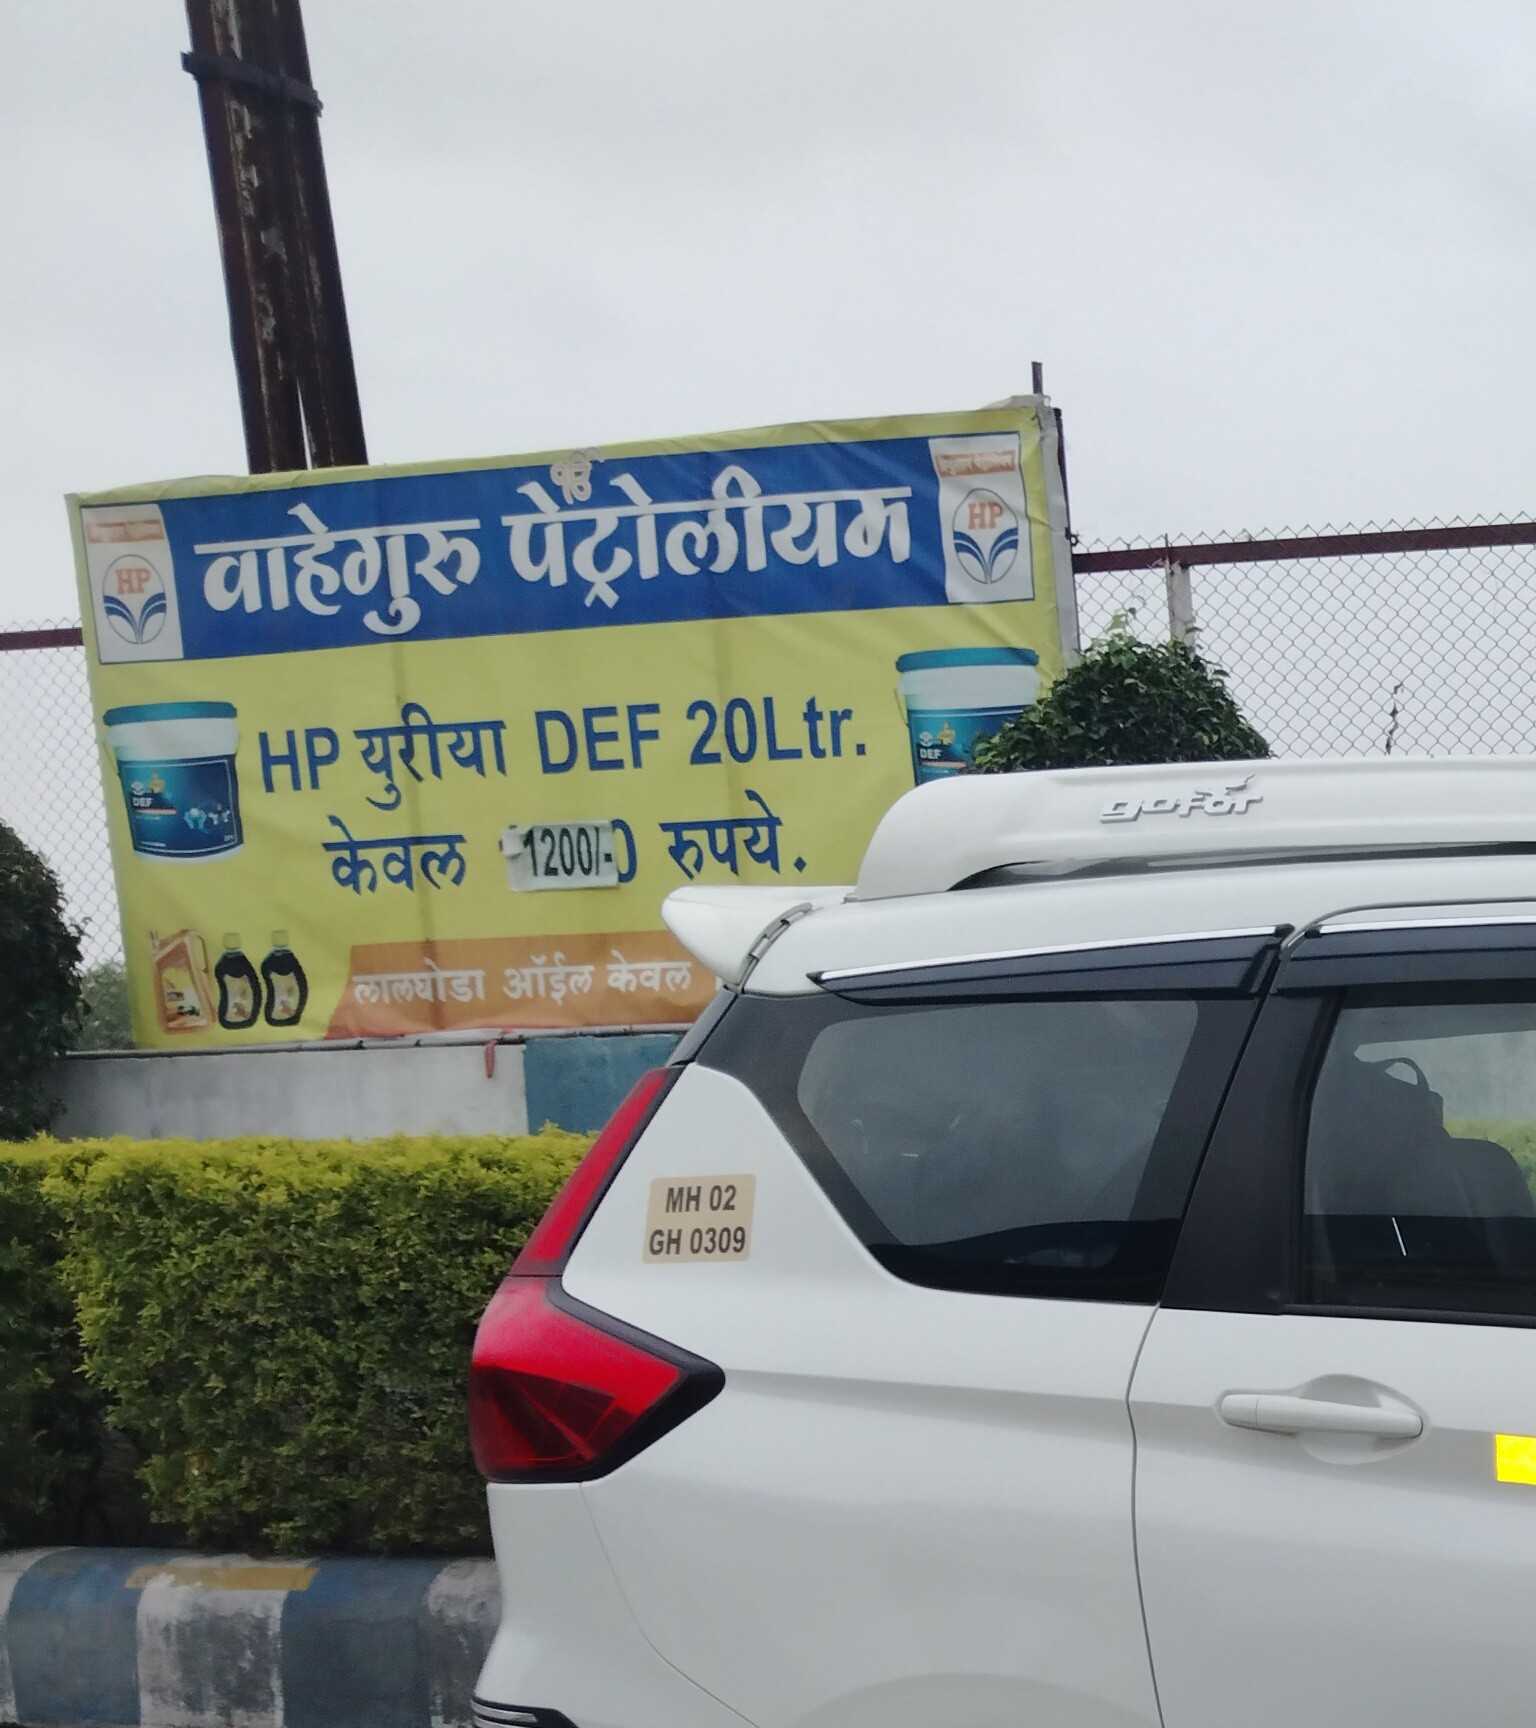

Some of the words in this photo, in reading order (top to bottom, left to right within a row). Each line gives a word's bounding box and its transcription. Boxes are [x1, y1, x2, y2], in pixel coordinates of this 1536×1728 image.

[964, 501, 1004, 530] HP
[115, 567, 151, 594] HP
[258, 727, 341, 793] HP
[353, 702, 507, 812] युरीया
[534, 703, 661, 775] DEF
[686, 696, 868, 766] 20Ltr.
[321, 815, 467, 896] केवल
[606, 948, 694, 993] केवल
[664, 1186, 702, 1213] MH
[709, 1185, 737, 1211] 02
[649, 1229, 683, 1256] GH
[689, 1227, 747, 1254] 0309
